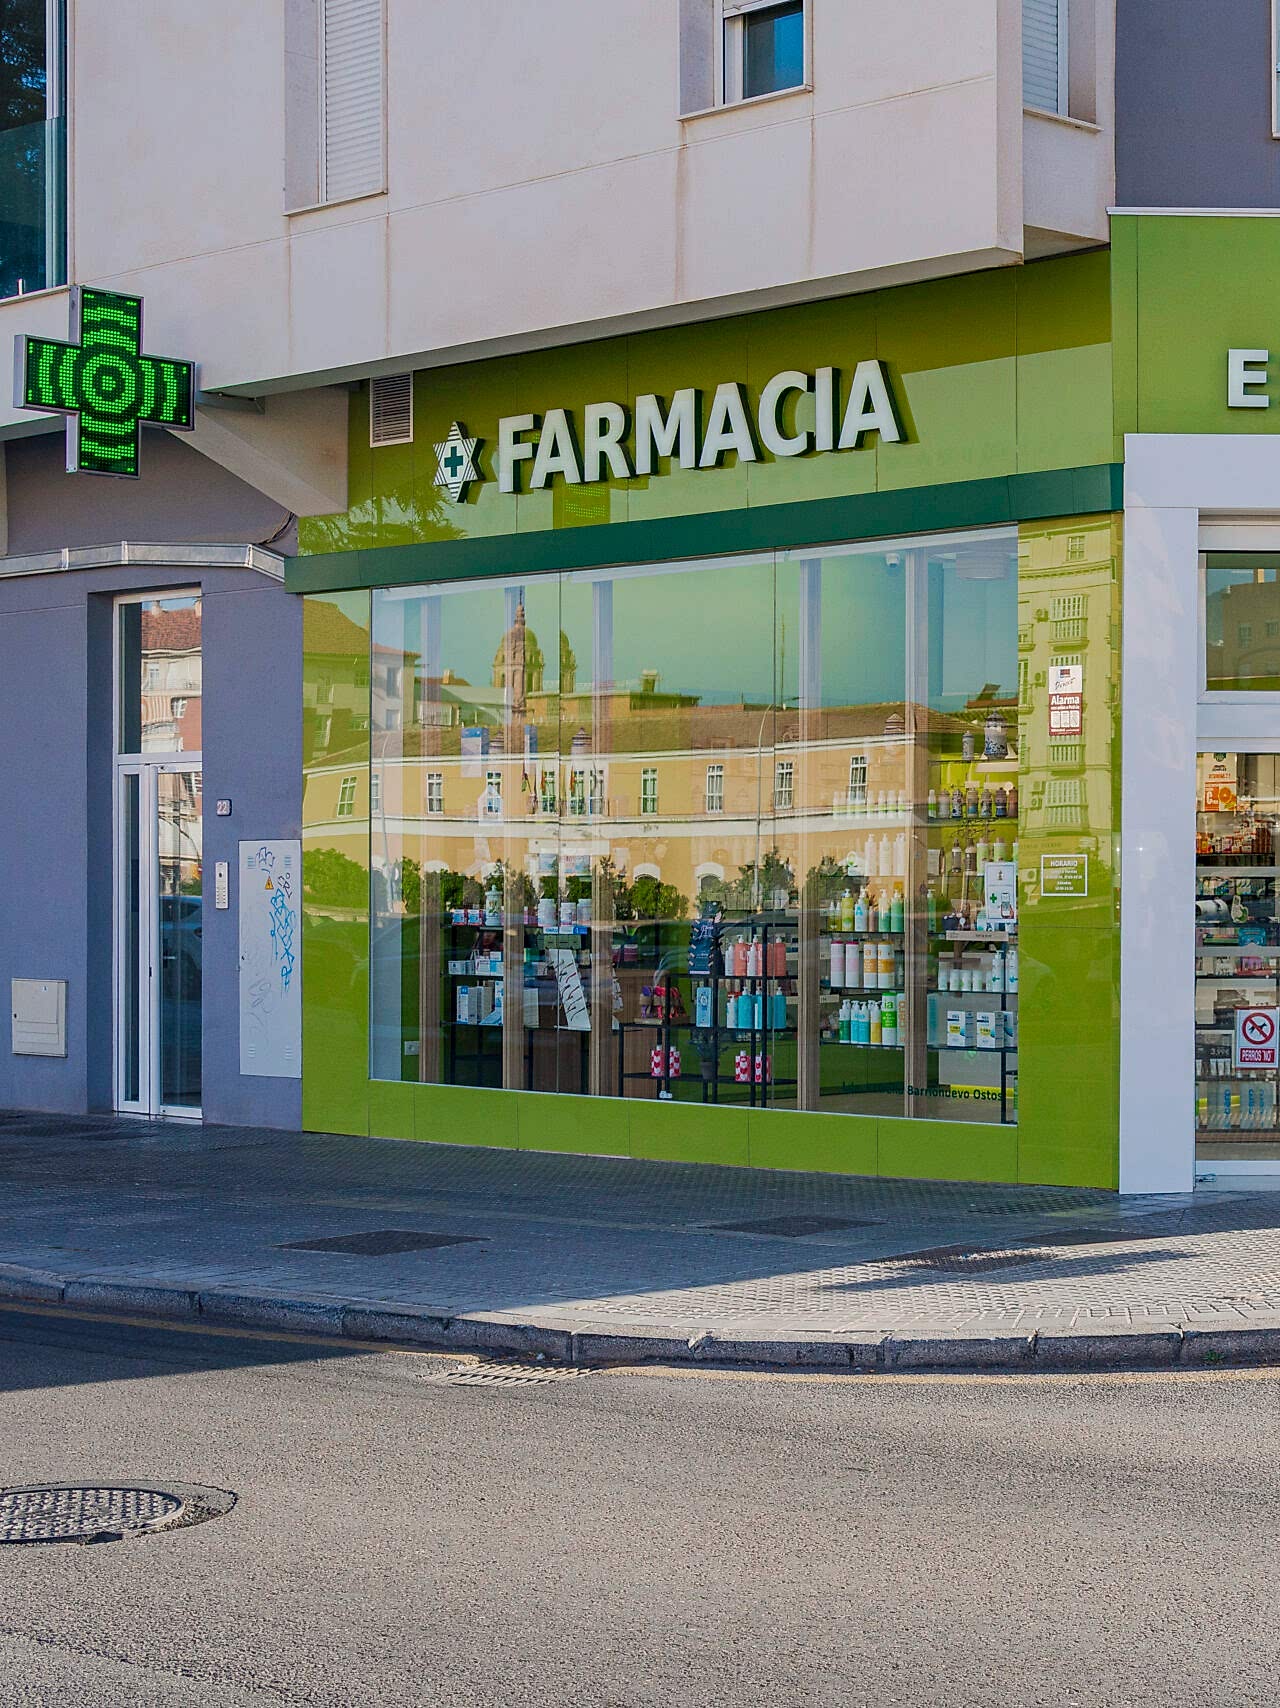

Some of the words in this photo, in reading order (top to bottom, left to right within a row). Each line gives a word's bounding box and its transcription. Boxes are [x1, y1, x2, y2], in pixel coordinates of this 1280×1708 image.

[498, 359, 901, 493] FARMACIA
[1051, 694, 1080, 705] Alarma
[1242, 1049, 1262, 1062] PERROS
[907, 1085, 970, 1099] Barrionuevo
[973, 1089, 1003, 1101] Ostos
